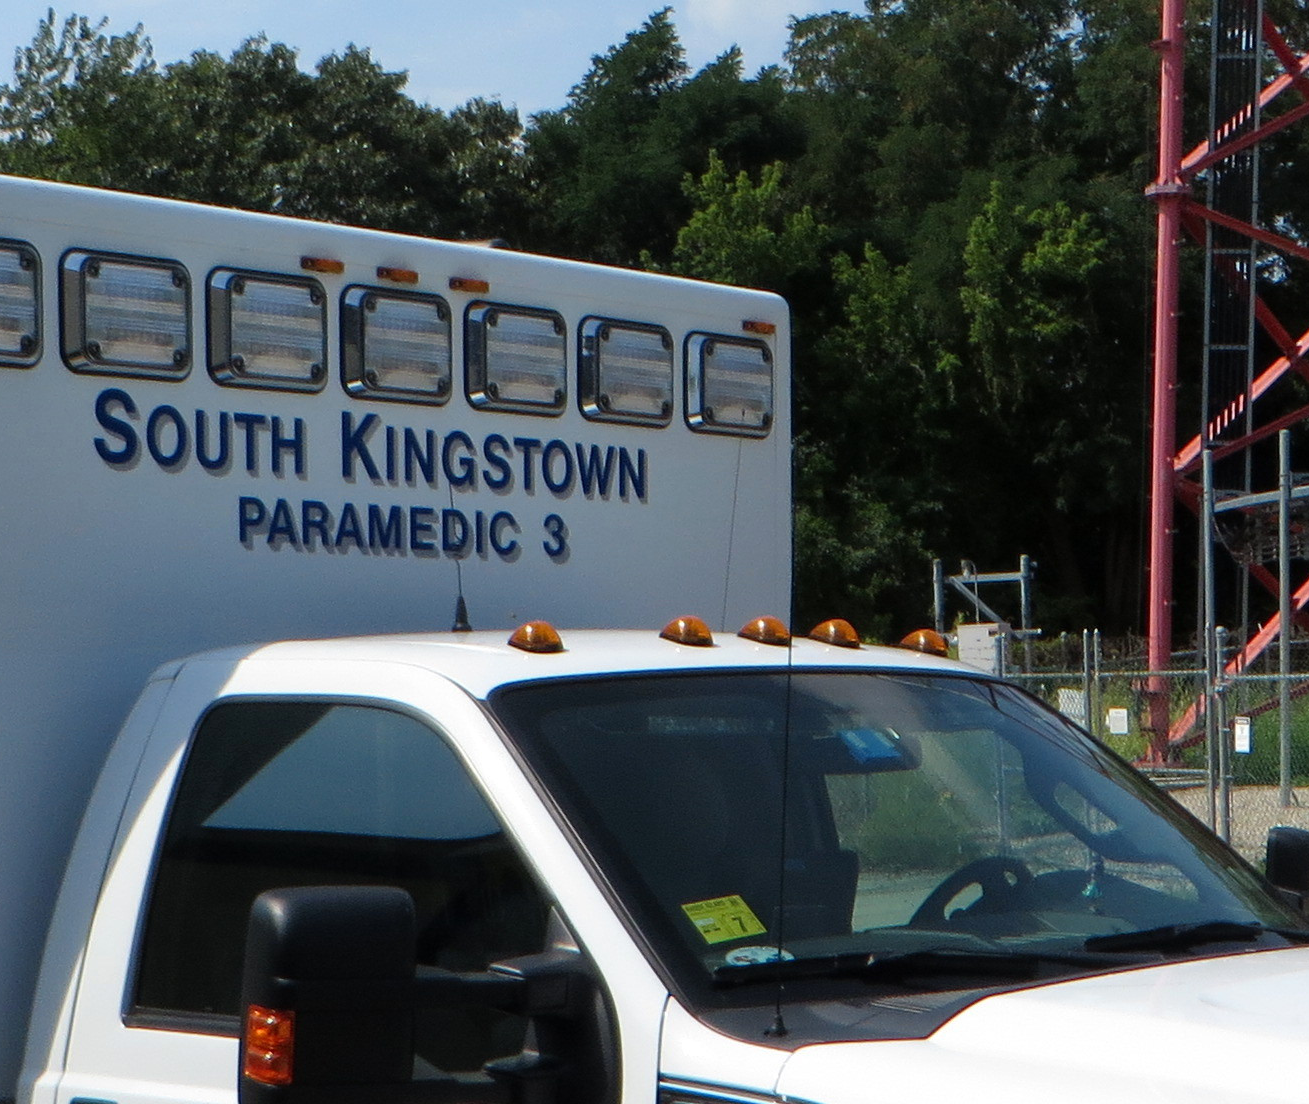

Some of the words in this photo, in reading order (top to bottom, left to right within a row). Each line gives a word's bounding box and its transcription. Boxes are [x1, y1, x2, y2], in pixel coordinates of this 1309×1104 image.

[93, 387, 307, 478] SOUTH
[341, 410, 652, 506] KINGSTOWN
[238, 495, 524, 563] PARAMEDIC
[542, 512, 572, 562] 3
